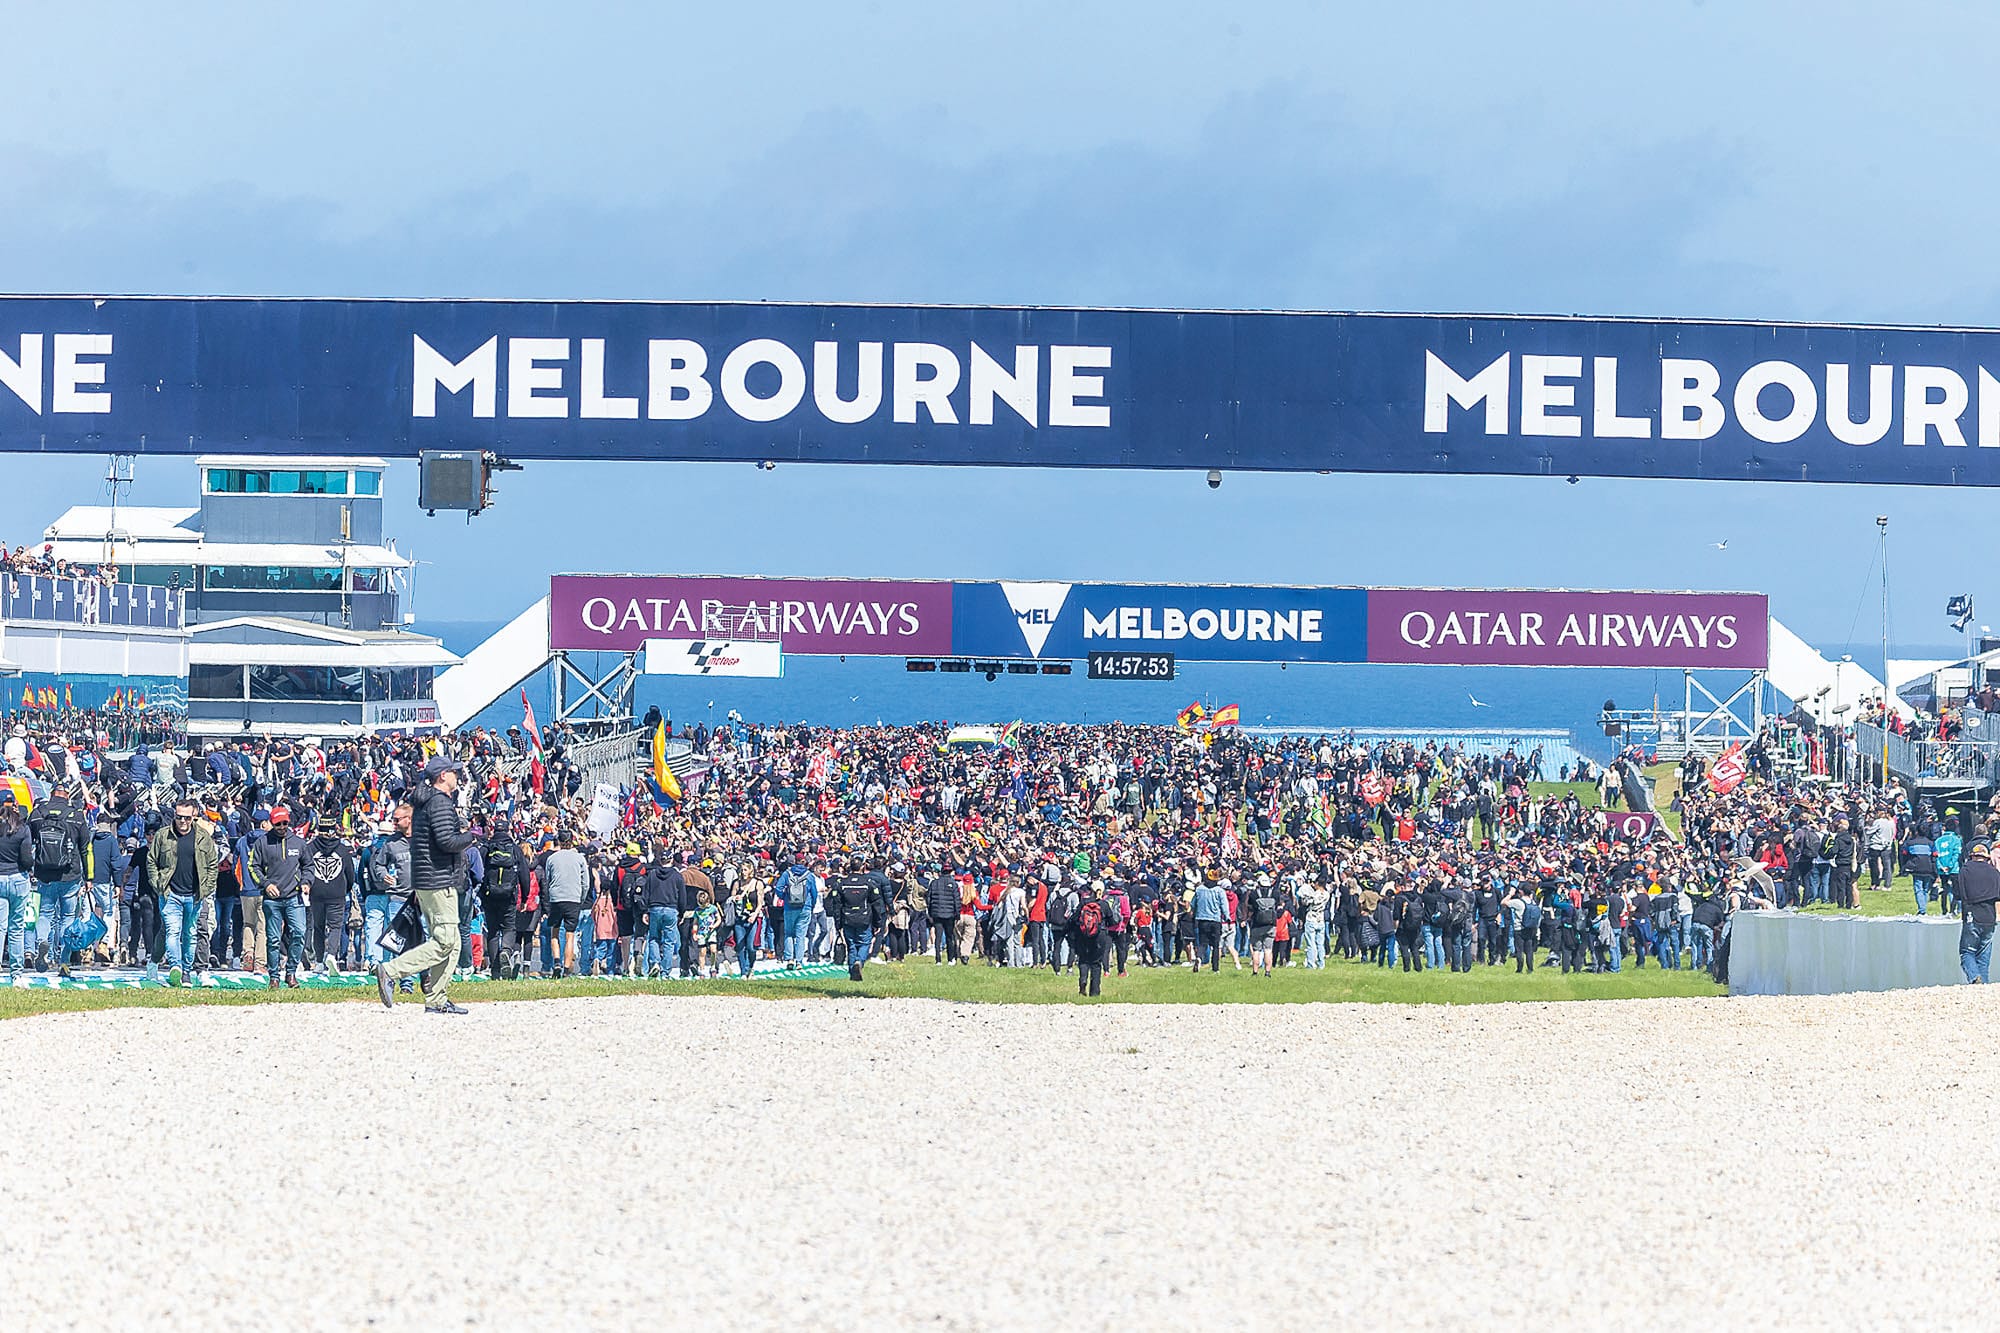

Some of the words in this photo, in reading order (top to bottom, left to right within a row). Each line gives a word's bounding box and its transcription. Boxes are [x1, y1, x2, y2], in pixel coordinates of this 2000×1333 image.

[412, 333, 1112, 429] MELBOURNE
[581, 597, 726, 634] QATAR
[737, 599, 920, 637] AIRWAYS
[1014, 608, 1056, 625] MEL
[1083, 607, 1323, 642] MELBOURNE
[1400, 611, 1546, 649] QATAR
[1556, 613, 1738, 649] AIRWAYS
[1094, 655, 1170, 677] 14:57:53
